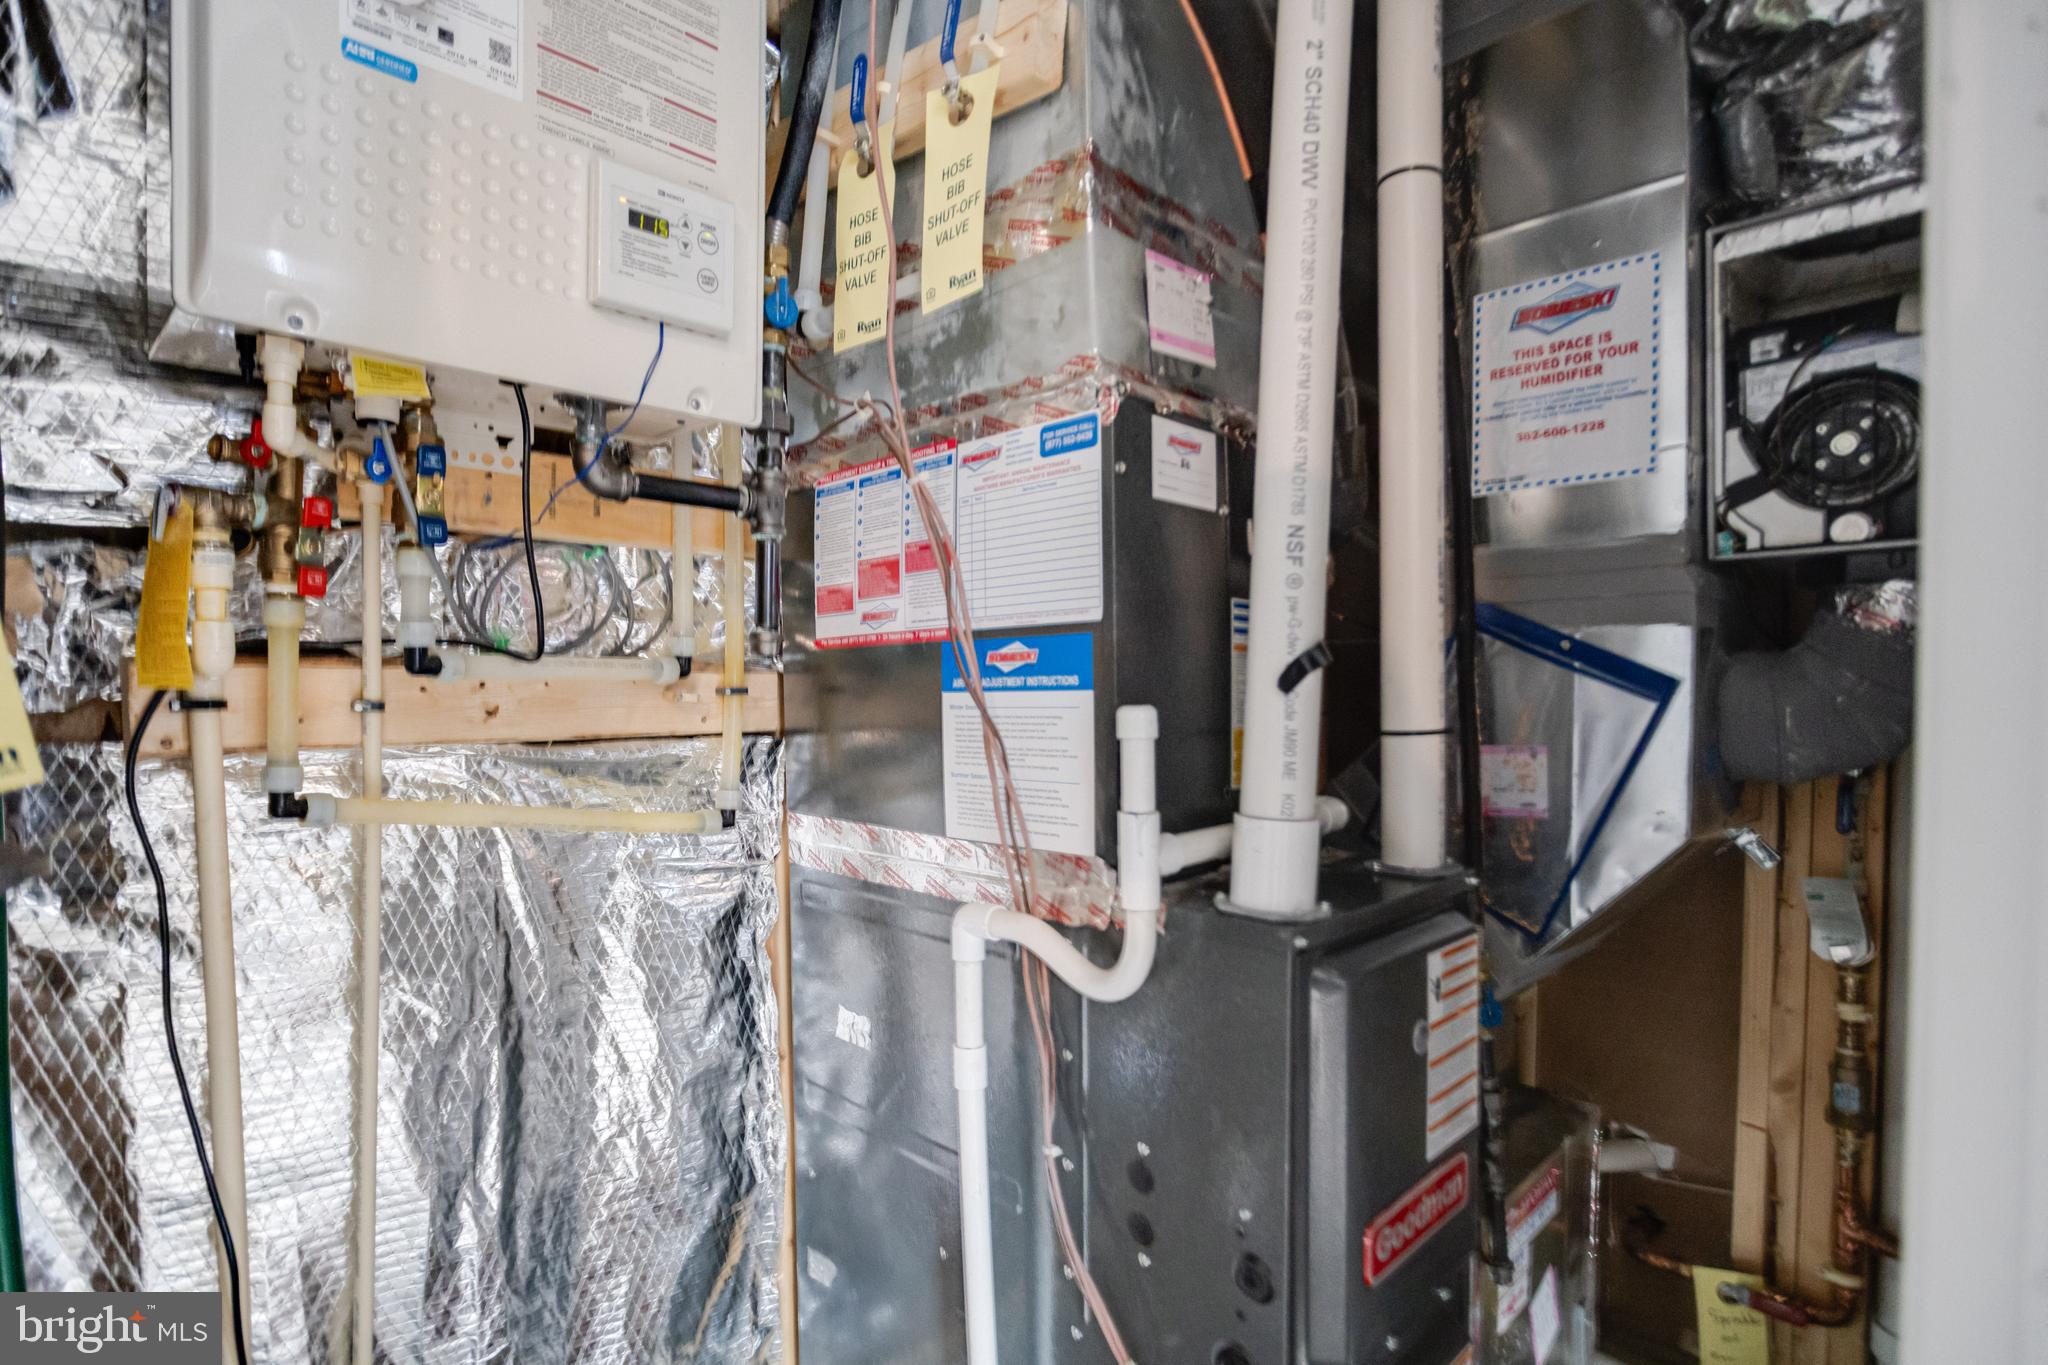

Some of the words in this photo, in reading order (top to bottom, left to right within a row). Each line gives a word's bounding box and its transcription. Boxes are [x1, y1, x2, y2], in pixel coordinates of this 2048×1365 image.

[1303, 66, 1323, 133] SCH40
[942, 154, 973, 181] HOSE
[1301, 140, 1320, 190] DWV
[946, 180, 965, 200] BIB
[849, 208, 879, 230] HOSE
[927, 191, 981, 230] SHUT-OFF
[854, 231, 872, 249] BIB
[935, 219, 969, 247] VALVE
[839, 245, 888, 274] SHUT-OFF
[845, 270, 877, 292] VALVE
[949, 269, 976, 289] Ryan
[857, 318, 882, 334] Ryan
[1513, 344, 1544, 361] THIS
[1549, 334, 1593, 353] SPACE
[1598, 330, 1613, 344] IS
[1296, 353, 1312, 389] ASTM
[1490, 358, 1560, 382] RESERVED
[1564, 351, 1593, 367] FOR
[1599, 341, 1640, 360] YOUR
[1520, 364, 1604, 390] HUMIDIFIER
[1291, 436, 1308, 473] ASTM
[1285, 524, 1305, 567] NSF
[1026, 675, 1080, 687] INSTRUCTIONS
[1374, 1170, 1463, 1263] Goodman
